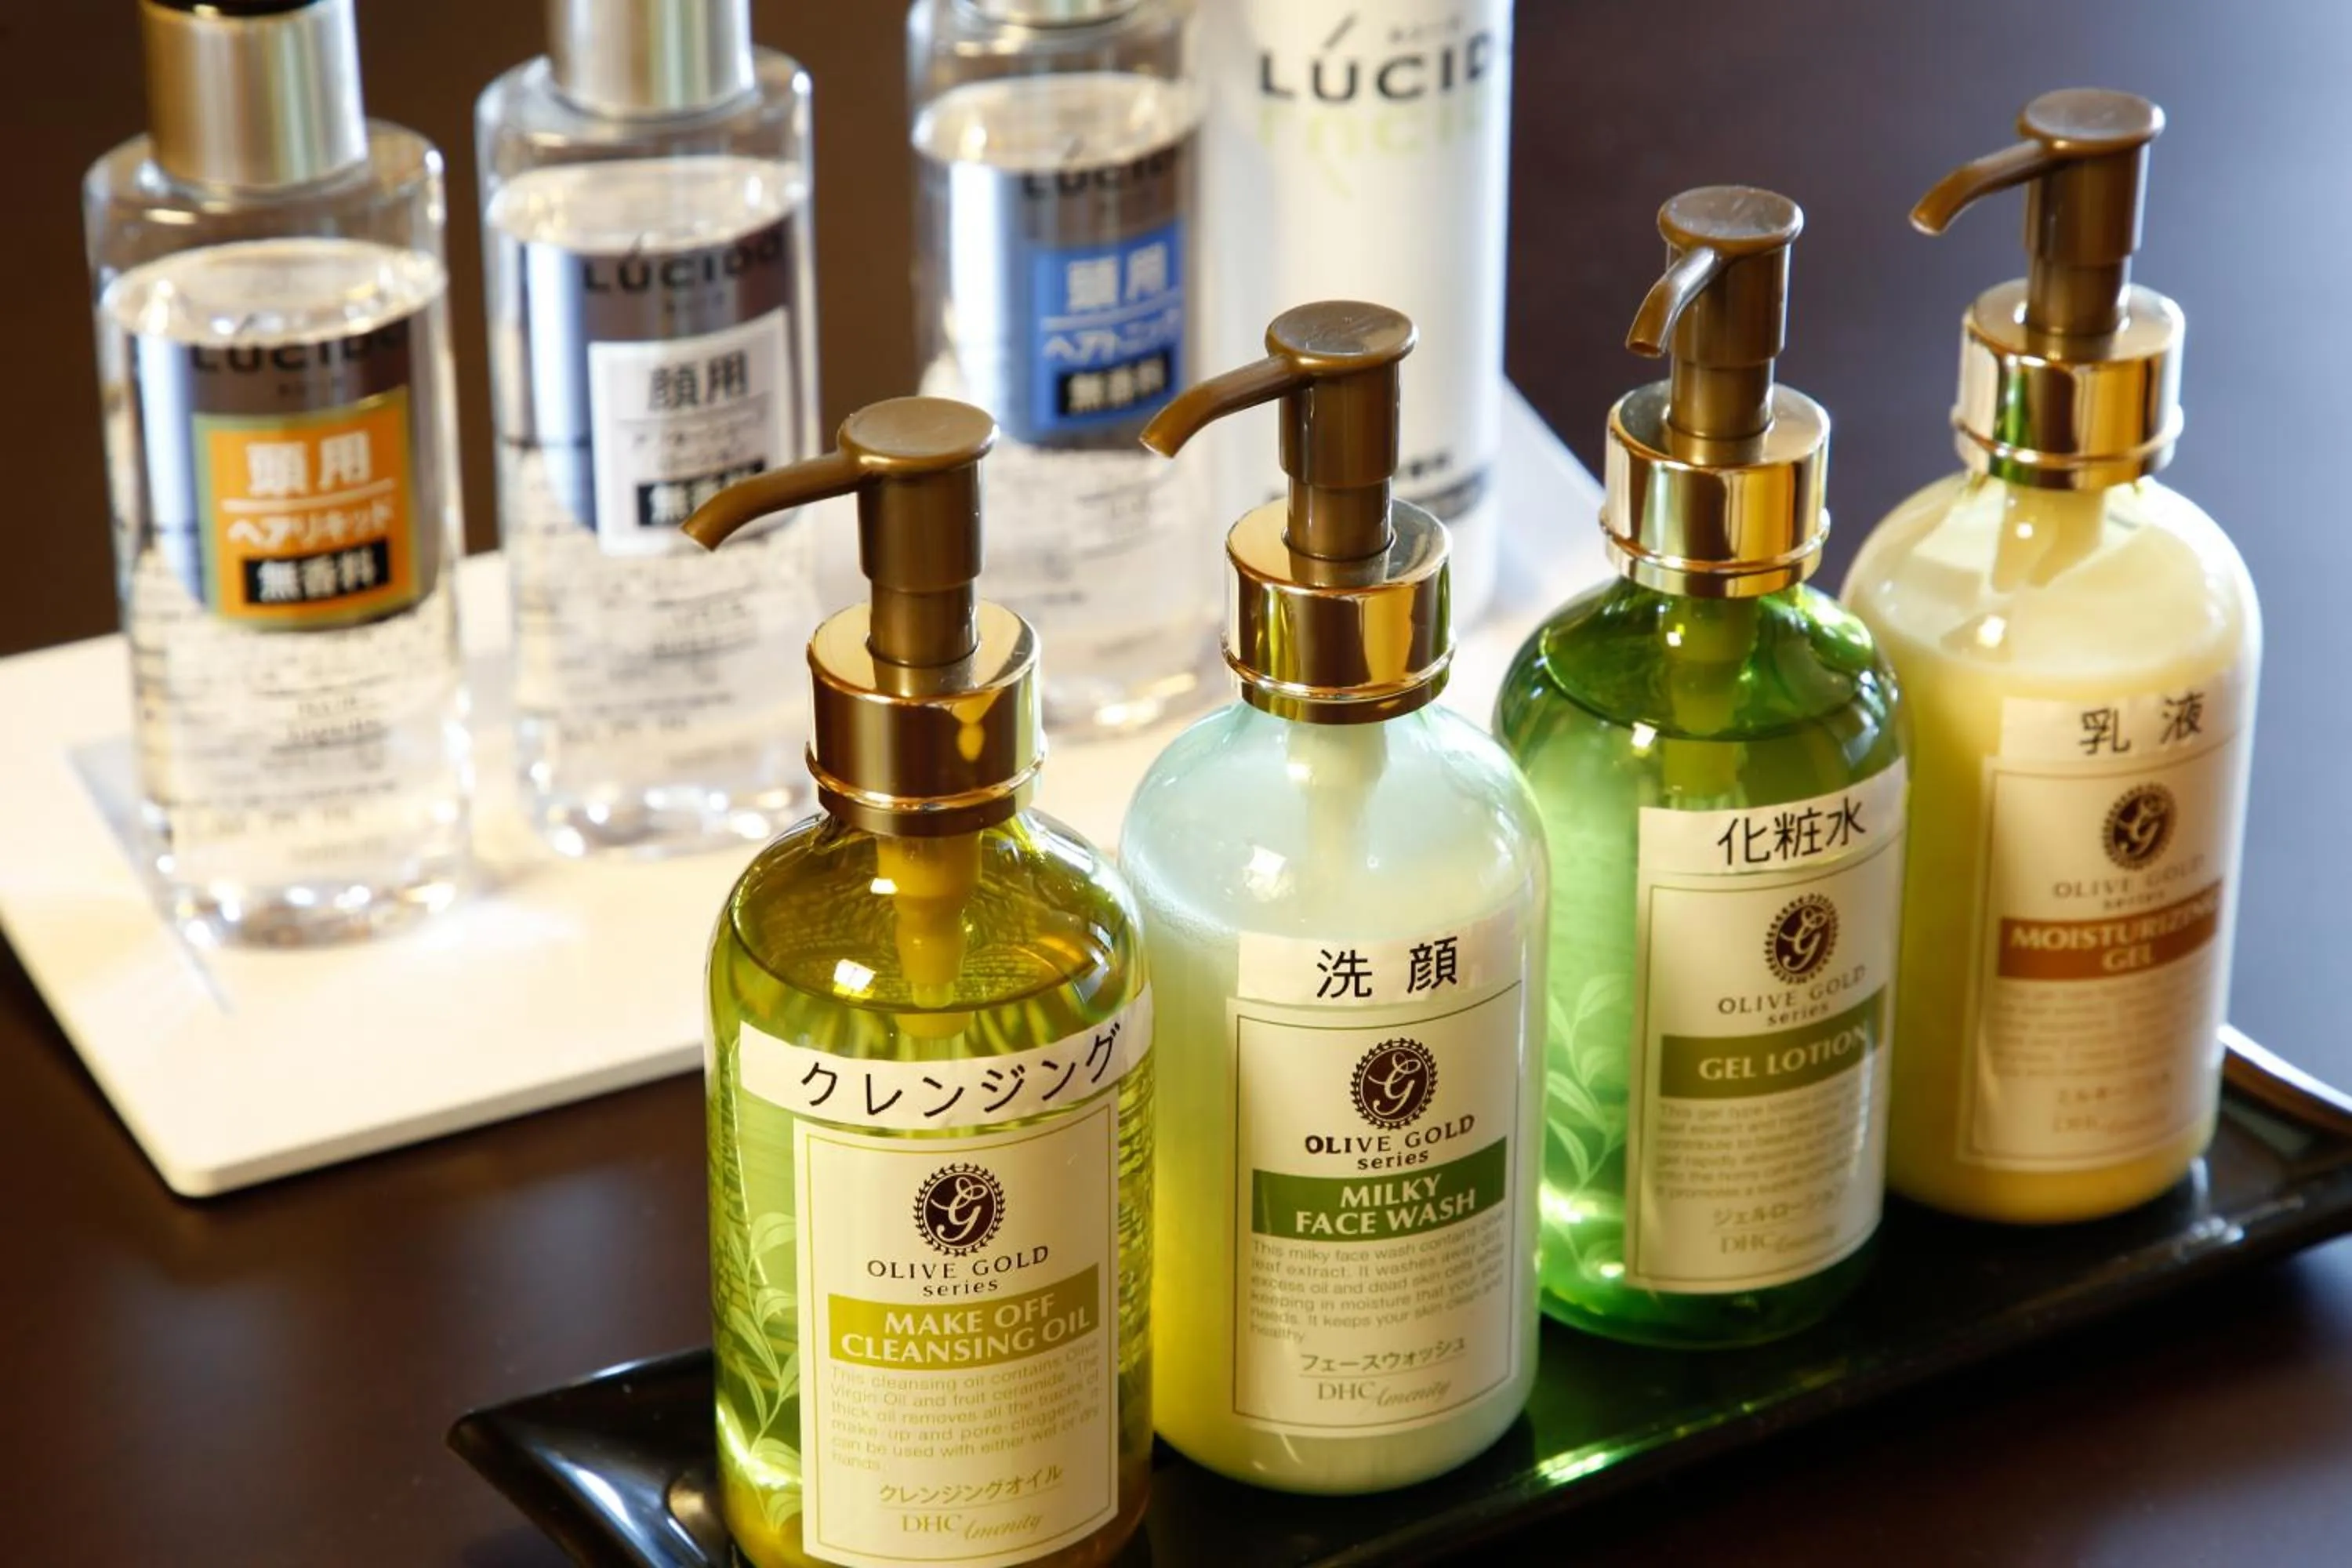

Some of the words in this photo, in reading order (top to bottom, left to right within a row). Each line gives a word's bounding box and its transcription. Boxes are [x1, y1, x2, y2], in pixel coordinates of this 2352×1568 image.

[260, 550, 374, 603] 無香料
[2078, 691, 2205, 756] 乳液
[1717, 797, 1866, 866] 化粧水
[1717, 989, 1797, 1015] OLIVE
[1809, 964, 1867, 1001] GOLD
[1767, 1002, 1830, 1026] series
[800, 1022, 1121, 1117] クレンジング
[1697, 1054, 1758, 1081] GEL
[1305, 1134, 1392, 1155] OLIVE
[1405, 1113, 1475, 1149] GOLD
[1357, 1150, 1428, 1171] series
[1340, 1173, 1443, 1208] MILKY
[1296, 1211, 1377, 1236] FACE
[1385, 1188, 1476, 1232] WASH
[867, 1260, 957, 1279] OLIVE
[972, 1244, 1050, 1276] GOLD
[1253, 1240, 1283, 1258] This
[1289, 1247, 1330, 1265] milky
[1335, 1249, 1370, 1262] face
[1374, 1243, 1416, 1260] wash
[1375, 1256, 1436, 1277] washes
[922, 1279, 999, 1298] series
[1310, 1281, 1328, 1294] oil
[1334, 1281, 1363, 1294] and
[1368, 1276, 1407, 1294] dead
[884, 1309, 983, 1337] MAKE
[994, 1293, 1055, 1327] OFF
[1320, 1298, 1335, 1311] in
[1341, 1294, 1411, 1311] moisture
[1374, 1310, 1410, 1329] your
[840, 1327, 1036, 1364] CLEANSING
[1042, 1305, 1091, 1341] OIL
[1299, 1336, 1466, 1372] フェースウォッシュ
[832, 1366, 865, 1385] This
[869, 1375, 957, 1392] cleansing
[964, 1374, 984, 1388] oil
[990, 1357, 1062, 1385] contains
[831, 1382, 878, 1403] Virgin
[884, 1391, 906, 1406] Oil
[913, 1395, 946, 1407] and
[954, 1391, 985, 1407] fruit
[1318, 1380, 1377, 1401] DHC
[832, 1399, 870, 1418] thick
[877, 1409, 896, 1422] oil
[902, 1410, 978, 1425] removes
[983, 1404, 1001, 1420] all
[1008, 1400, 1034, 1416] the
[832, 1419, 878, 1436] make
[888, 1428, 910, 1443] up
[918, 1427, 953, 1441] and
[832, 1436, 861, 1452] can
[866, 1441, 887, 1456] be
[893, 1444, 935, 1458] used
[940, 1443, 976, 1458] with
[981, 1435, 1024, 1455] either
[879, 1464, 1065, 1504] クレンジングオイル
[902, 1513, 963, 1533] DHC
